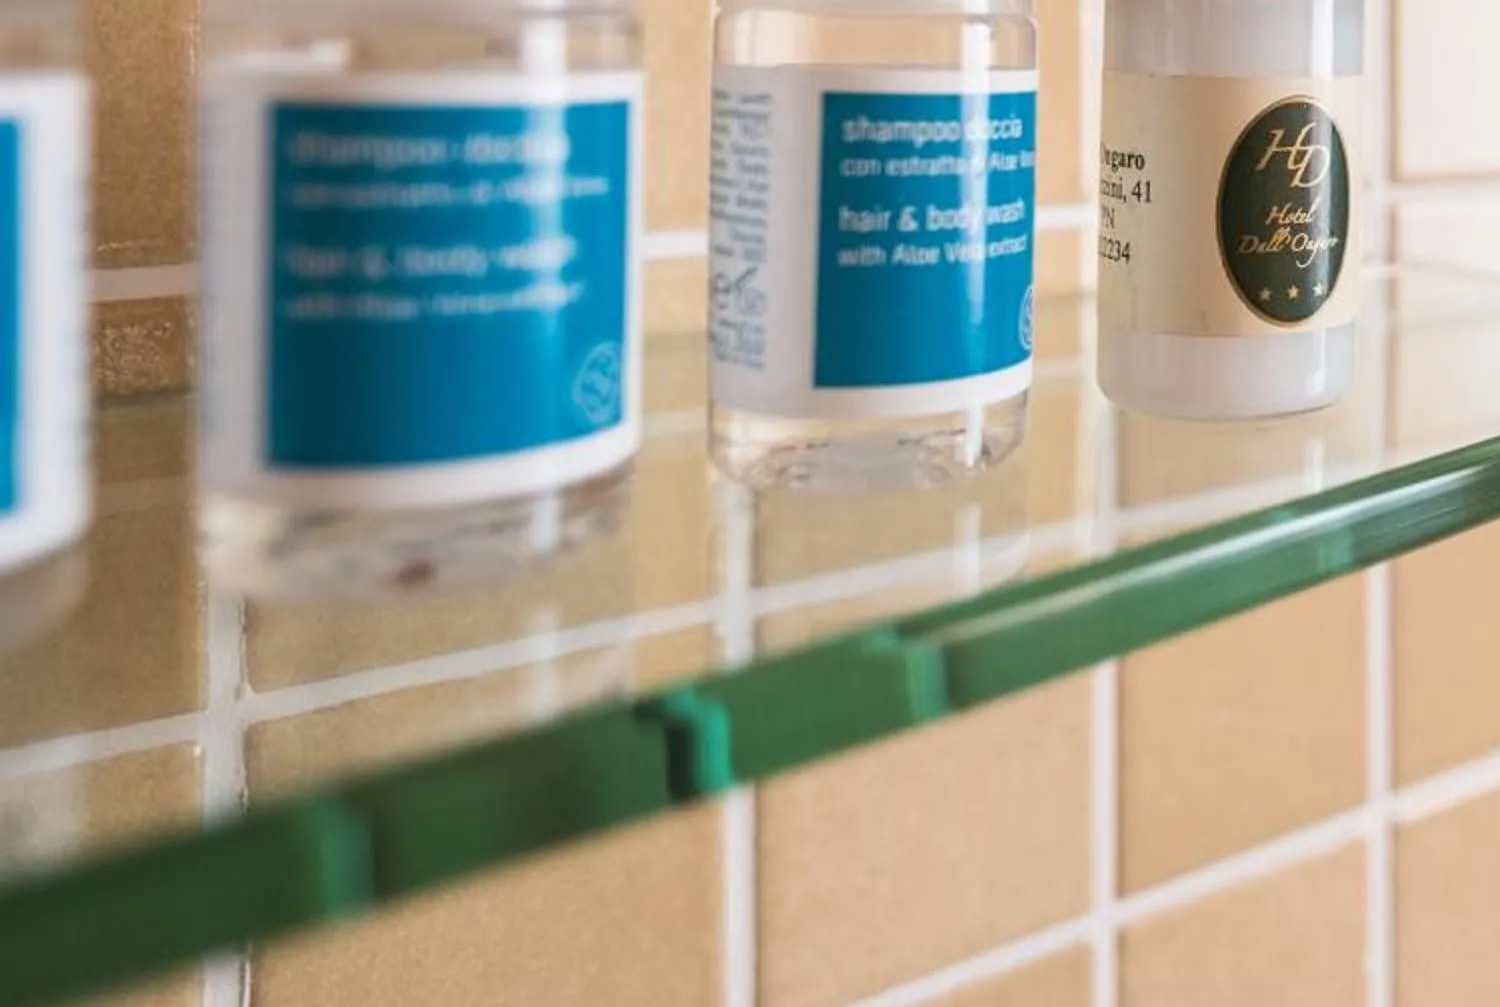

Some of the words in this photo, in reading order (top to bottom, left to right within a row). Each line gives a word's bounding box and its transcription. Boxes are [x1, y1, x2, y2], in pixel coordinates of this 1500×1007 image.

[840, 114, 961, 148] shampoo
[839, 157, 881, 177] con
[884, 155, 965, 177] estratto
[1131, 180, 1152, 204] 41
[837, 203, 890, 232] hair
[896, 204, 919, 232] &
[1265, 197, 1320, 225] Hotel
[837, 244, 886, 268] with
[890, 241, 940, 266] Aloe
